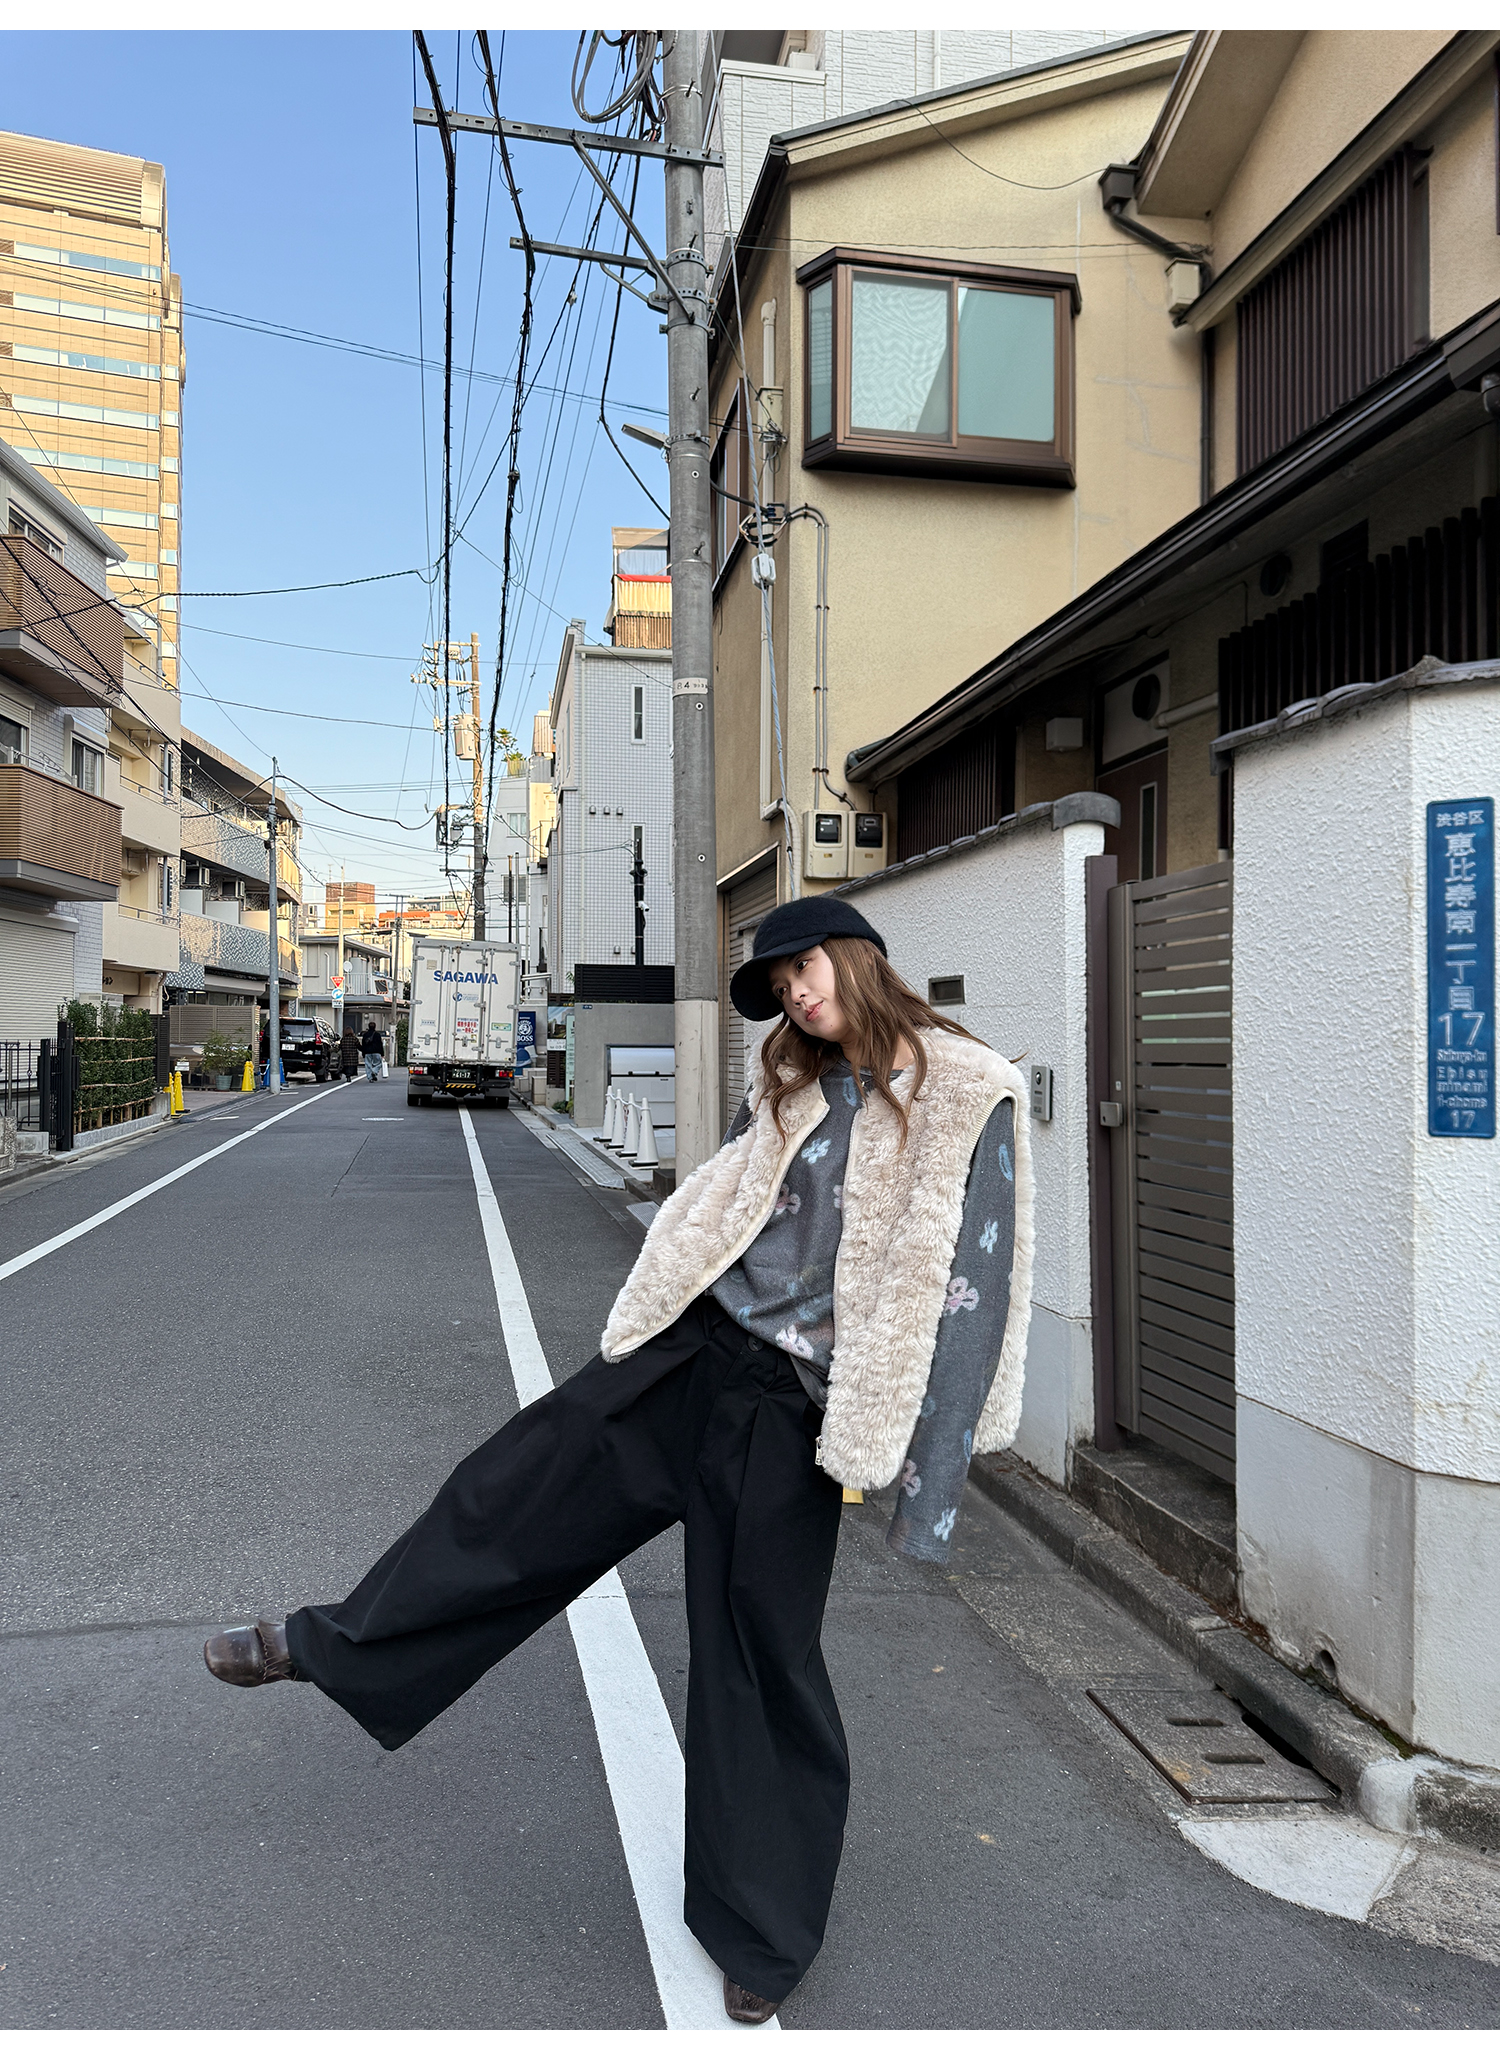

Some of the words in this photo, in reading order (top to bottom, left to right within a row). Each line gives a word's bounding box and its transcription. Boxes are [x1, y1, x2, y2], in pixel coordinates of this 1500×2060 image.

[1436, 810, 1484, 828] 渋谷区
[1444, 832, 1477, 1010] 恵比寿南一丁目
[433, 970, 499, 985] SAGAWA
[1438, 1011, 1485, 1046] 17
[1436, 1048, 1487, 1063] Shibuya-ku
[1436, 1066, 1488, 1079] Ebisu
[1436, 1080, 1488, 1092] minami
[1437, 1095, 1488, 1108] 1-chome
[1450, 1109, 1476, 1128] 17
